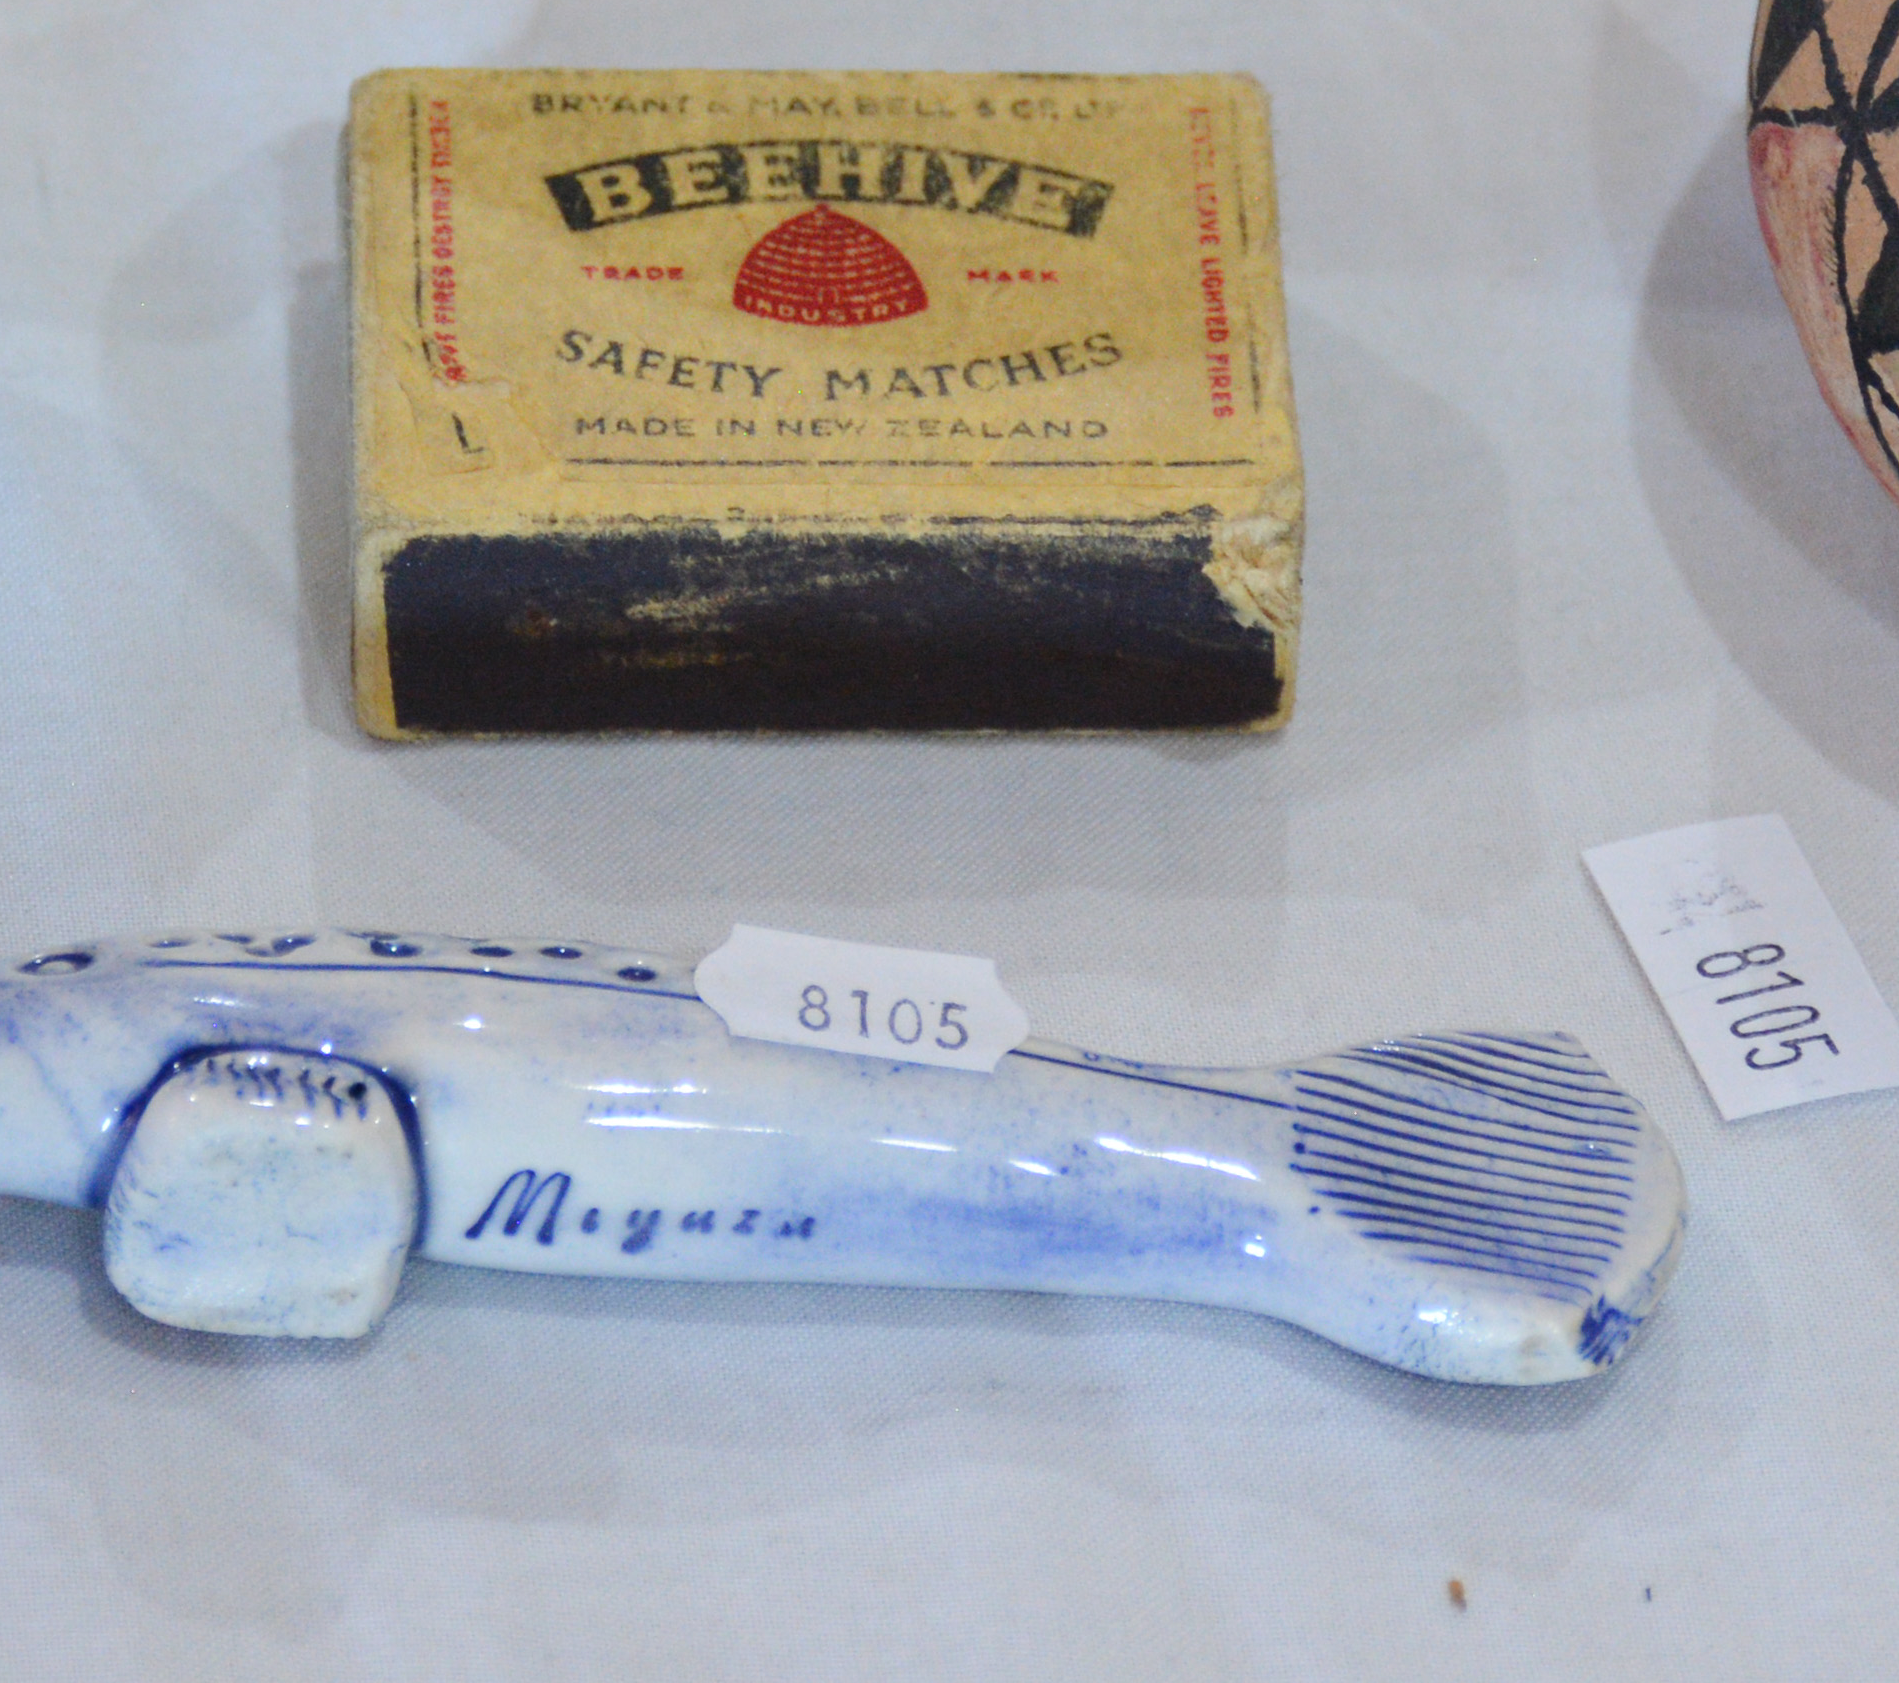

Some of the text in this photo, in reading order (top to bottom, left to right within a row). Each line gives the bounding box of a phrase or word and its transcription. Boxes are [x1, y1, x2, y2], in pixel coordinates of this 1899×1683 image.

[530, 92, 692, 115] BRYANT
[854, 94, 958, 119] BELL
[430, 175, 453, 259] DESTROY
[574, 142, 1086, 230] BEEHIVE
[431, 265, 455, 324] FIRES
[580, 263, 1062, 286] TRADE MARK
[1200, 256, 1230, 344] LIGHTED
[742, 294, 911, 325] INDUSTRY
[554, 327, 1125, 402] SAFETY MATCHES
[1206, 353, 1235, 419] FIRES
[574, 416, 1110, 440] MADE IN NEW ZEALAND
[797, 984, 969, 1051] 8105
[1695, 942, 1840, 1072] 8105
